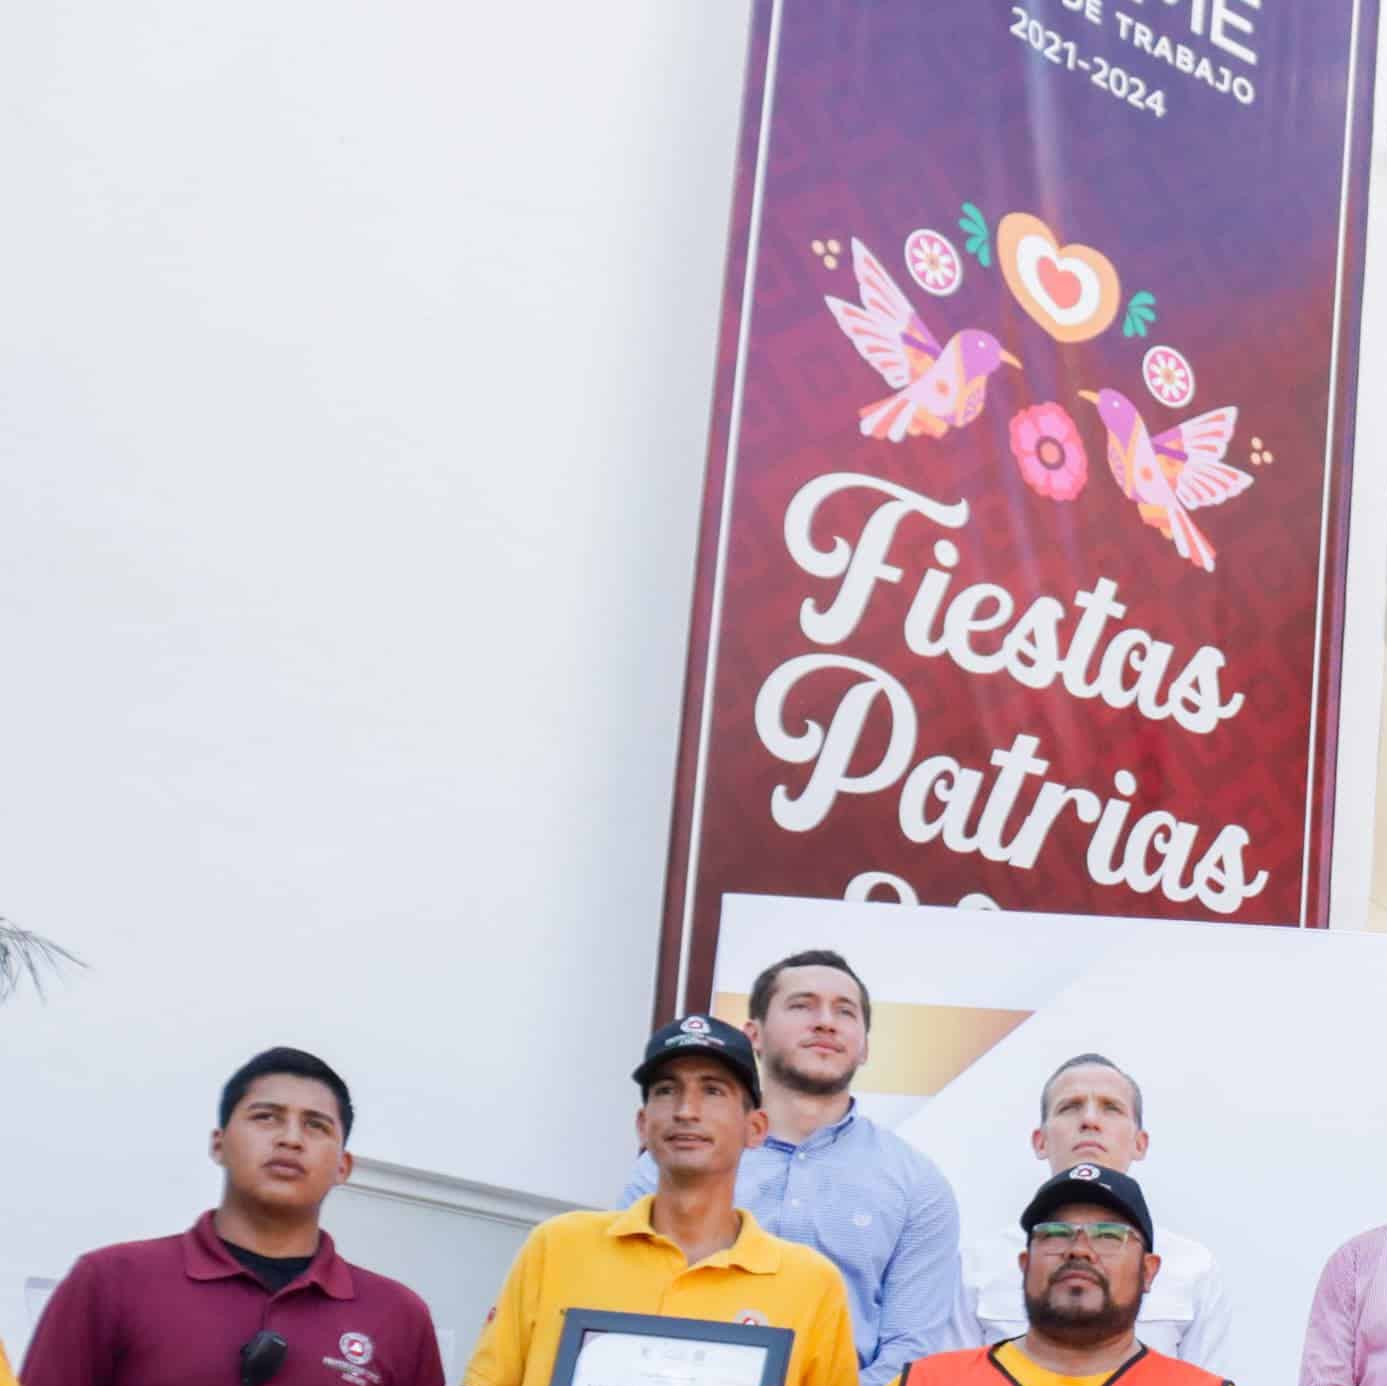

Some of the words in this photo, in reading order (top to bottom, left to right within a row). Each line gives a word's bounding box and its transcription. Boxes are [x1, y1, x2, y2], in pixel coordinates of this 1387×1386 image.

[1009, 7, 1167, 118] 2021-2024
[1115, 11, 1256, 104] TRABAJO
[783, 472, 1245, 735] Fiestas
[754, 653, 1269, 914] Patrias
